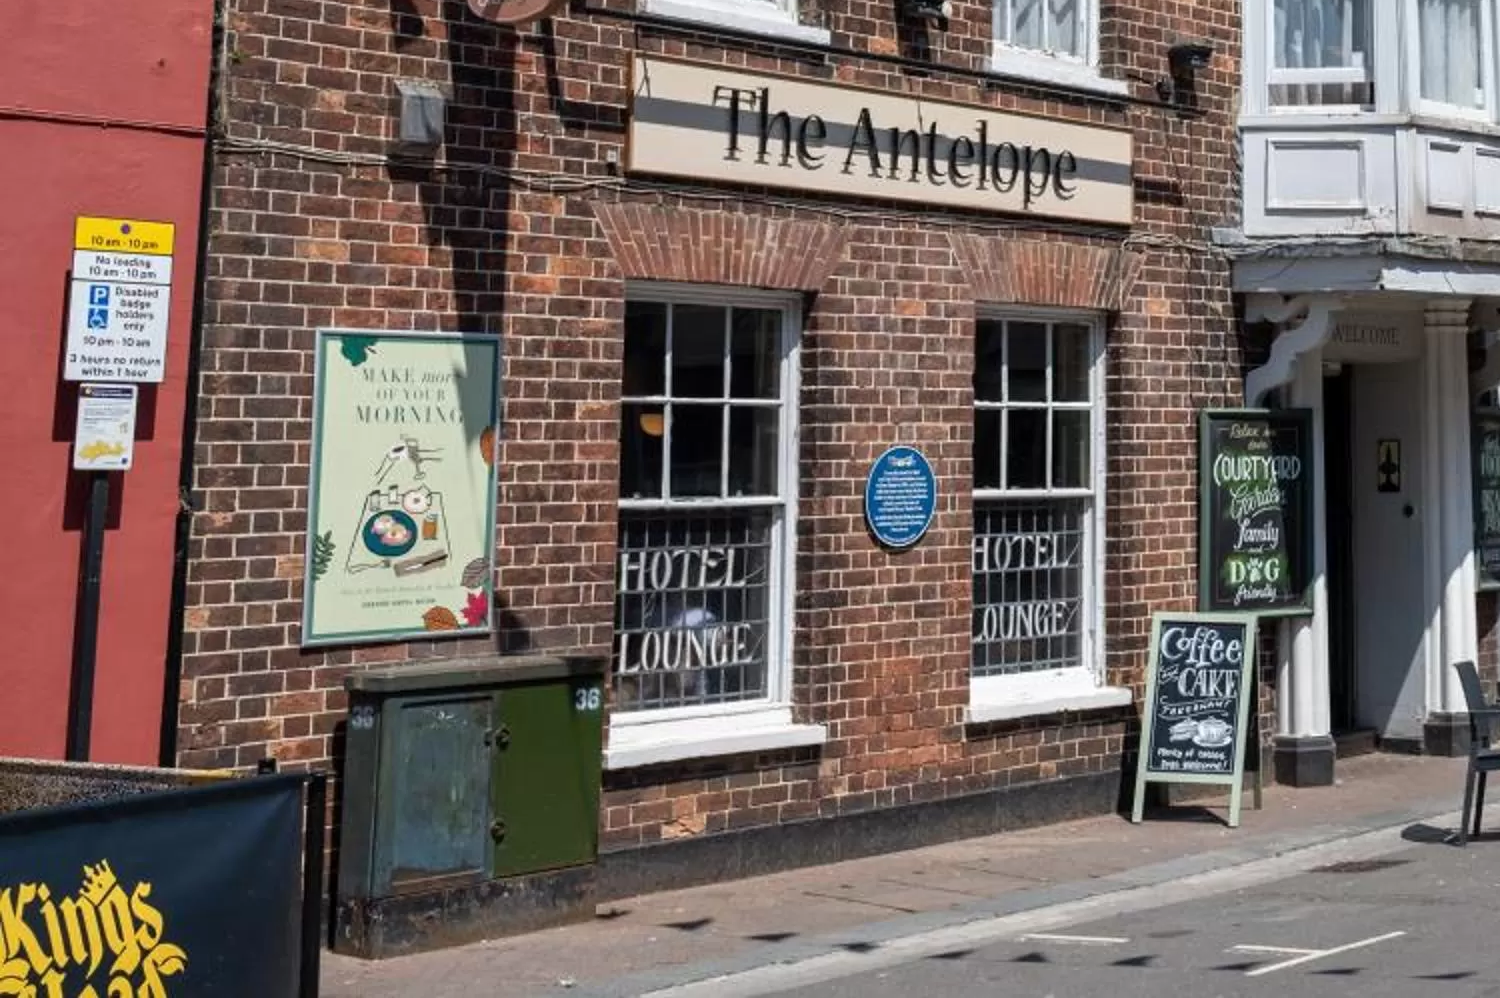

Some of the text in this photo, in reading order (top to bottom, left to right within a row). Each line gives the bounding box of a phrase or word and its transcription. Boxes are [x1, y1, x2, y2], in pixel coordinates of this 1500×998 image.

[713, 85, 1078, 210] The Antelope
[129, 238, 141, 248] 10
[96, 256, 110, 265] No
[104, 269, 119, 278] am
[128, 269, 139, 279] 10
[115, 286, 159, 299] Disabled
[80, 354, 110, 365] hours
[114, 357, 126, 365] no
[130, 357, 161, 366] return
[82, 366, 118, 377] within
[363, 367, 453, 384] MAKE mor
[376, 388, 446, 402] OF YOUR
[1213, 455, 1301, 487] COURTYARD
[1233, 517, 1279, 549] family
[972, 534, 1072, 571] HOTEL
[620, 548, 750, 591] HOTEL
[619, 623, 754, 674] LOUNGE
[1162, 625, 1241, 668] Coffee
[1178, 667, 1239, 698] CAKE
[576, 688, 600, 710] 36
[352, 707, 375, 728] 36
[0, 881, 163, 978] Kings
